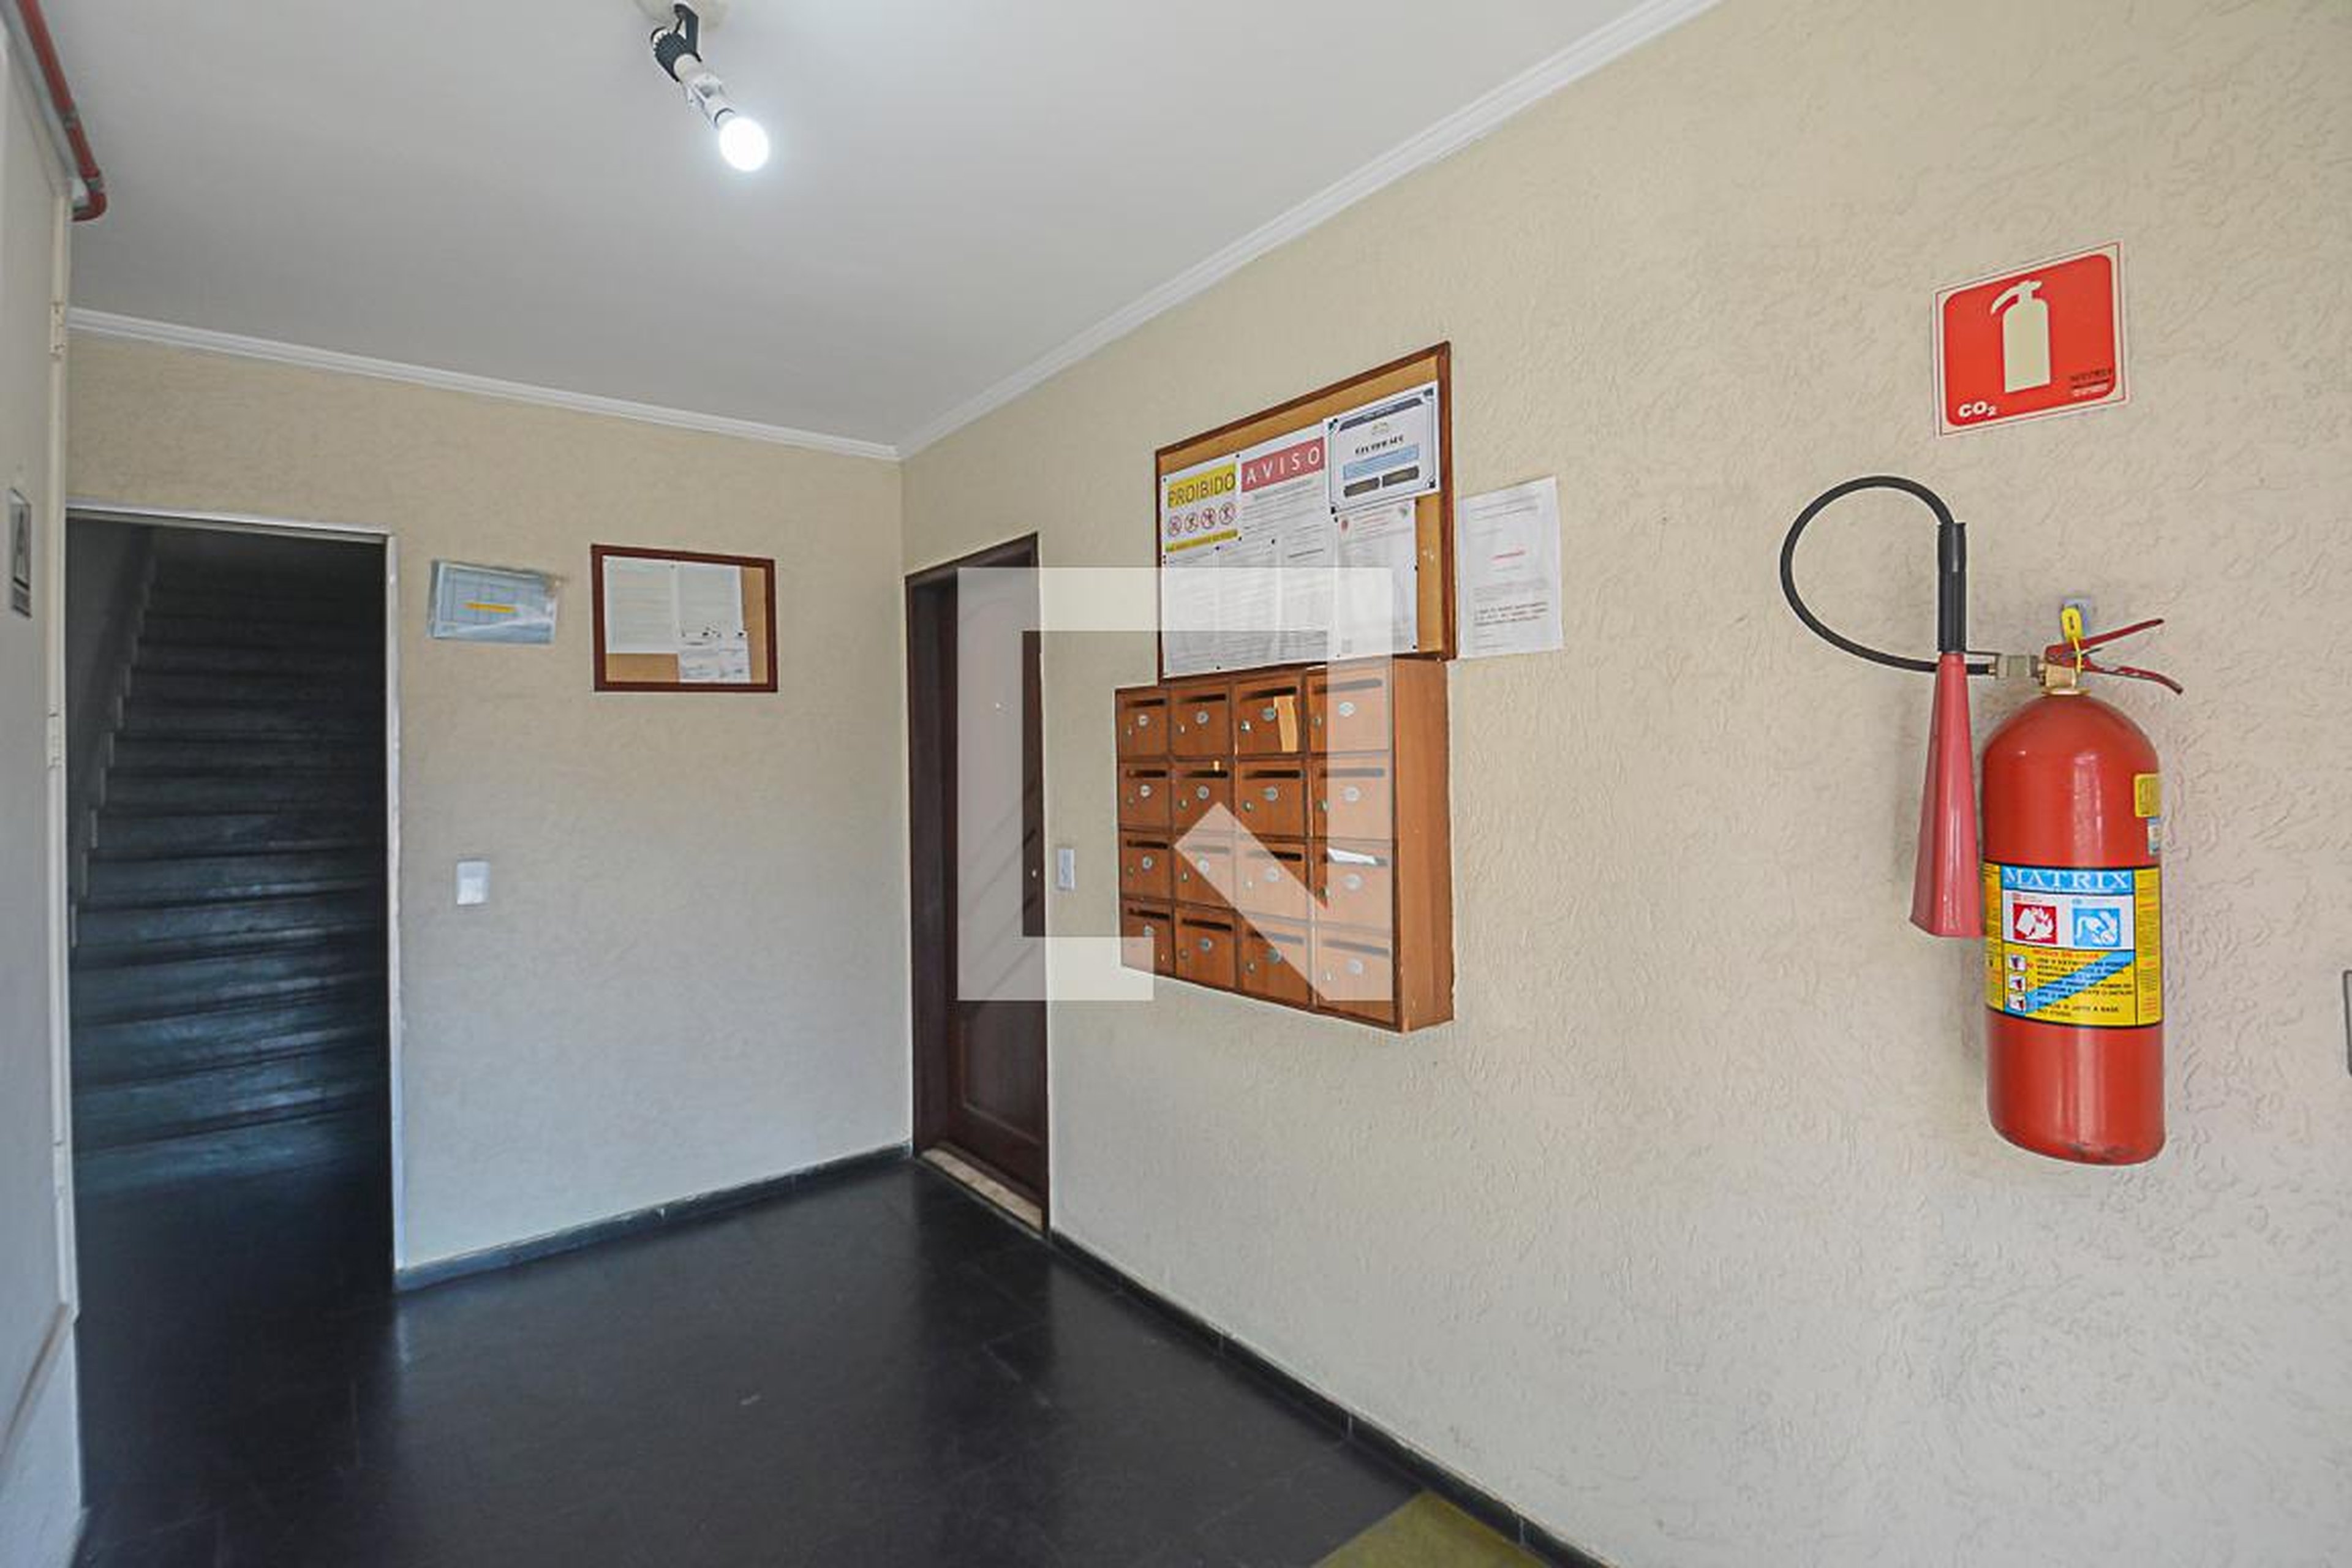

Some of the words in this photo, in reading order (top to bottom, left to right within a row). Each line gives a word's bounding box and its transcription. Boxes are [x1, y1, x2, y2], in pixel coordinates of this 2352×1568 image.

[1246, 446, 1321, 484] AVISO
[1167, 472, 1236, 509] PROIBIDO
[2004, 868, 2129, 889] MATRIX
